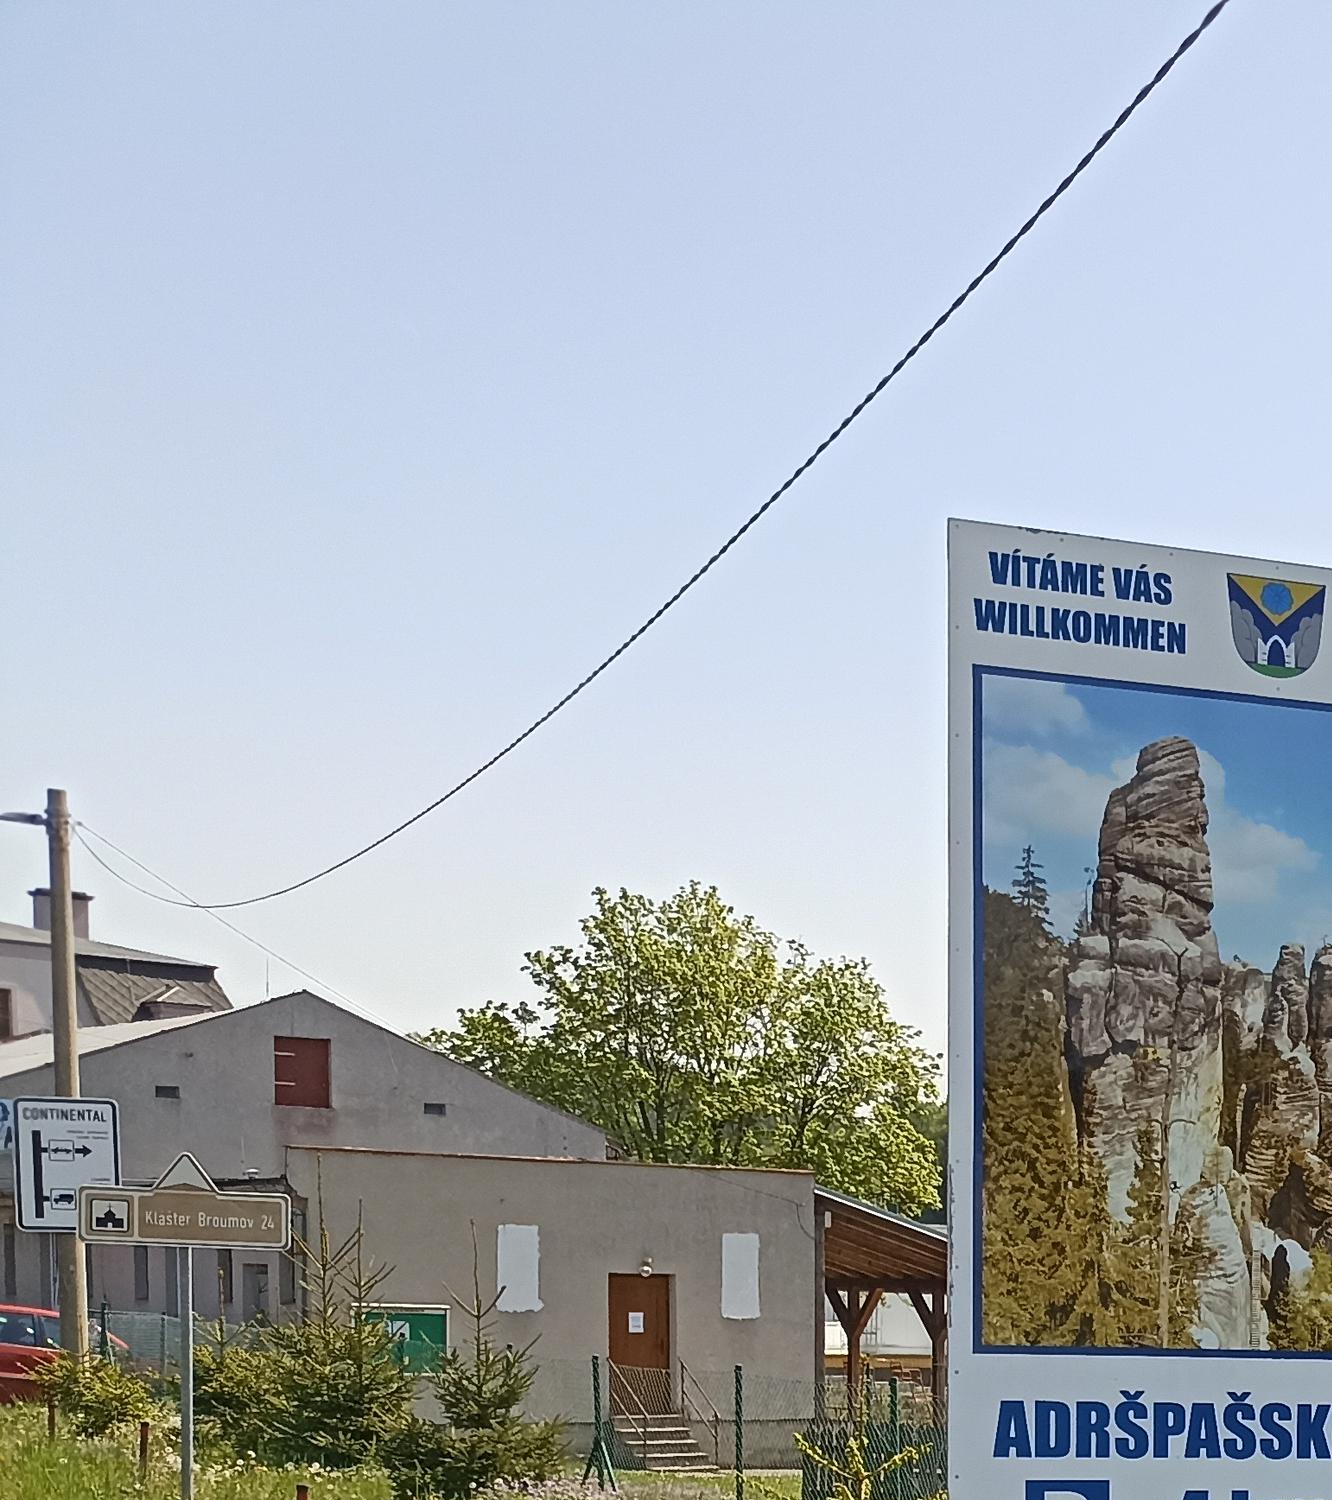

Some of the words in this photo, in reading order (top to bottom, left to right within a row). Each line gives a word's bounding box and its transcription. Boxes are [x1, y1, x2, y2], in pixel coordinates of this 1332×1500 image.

[988, 549, 1105, 598] VÍTÁME
[1112, 564, 1173, 606] VÁS
[973, 598, 1187, 655] WILLKOMMEN
[22, 1107, 106, 1122] CONTINENTAL
[198, 1211, 254, 1229] Broumov
[261, 1214, 275, 1230] 24
